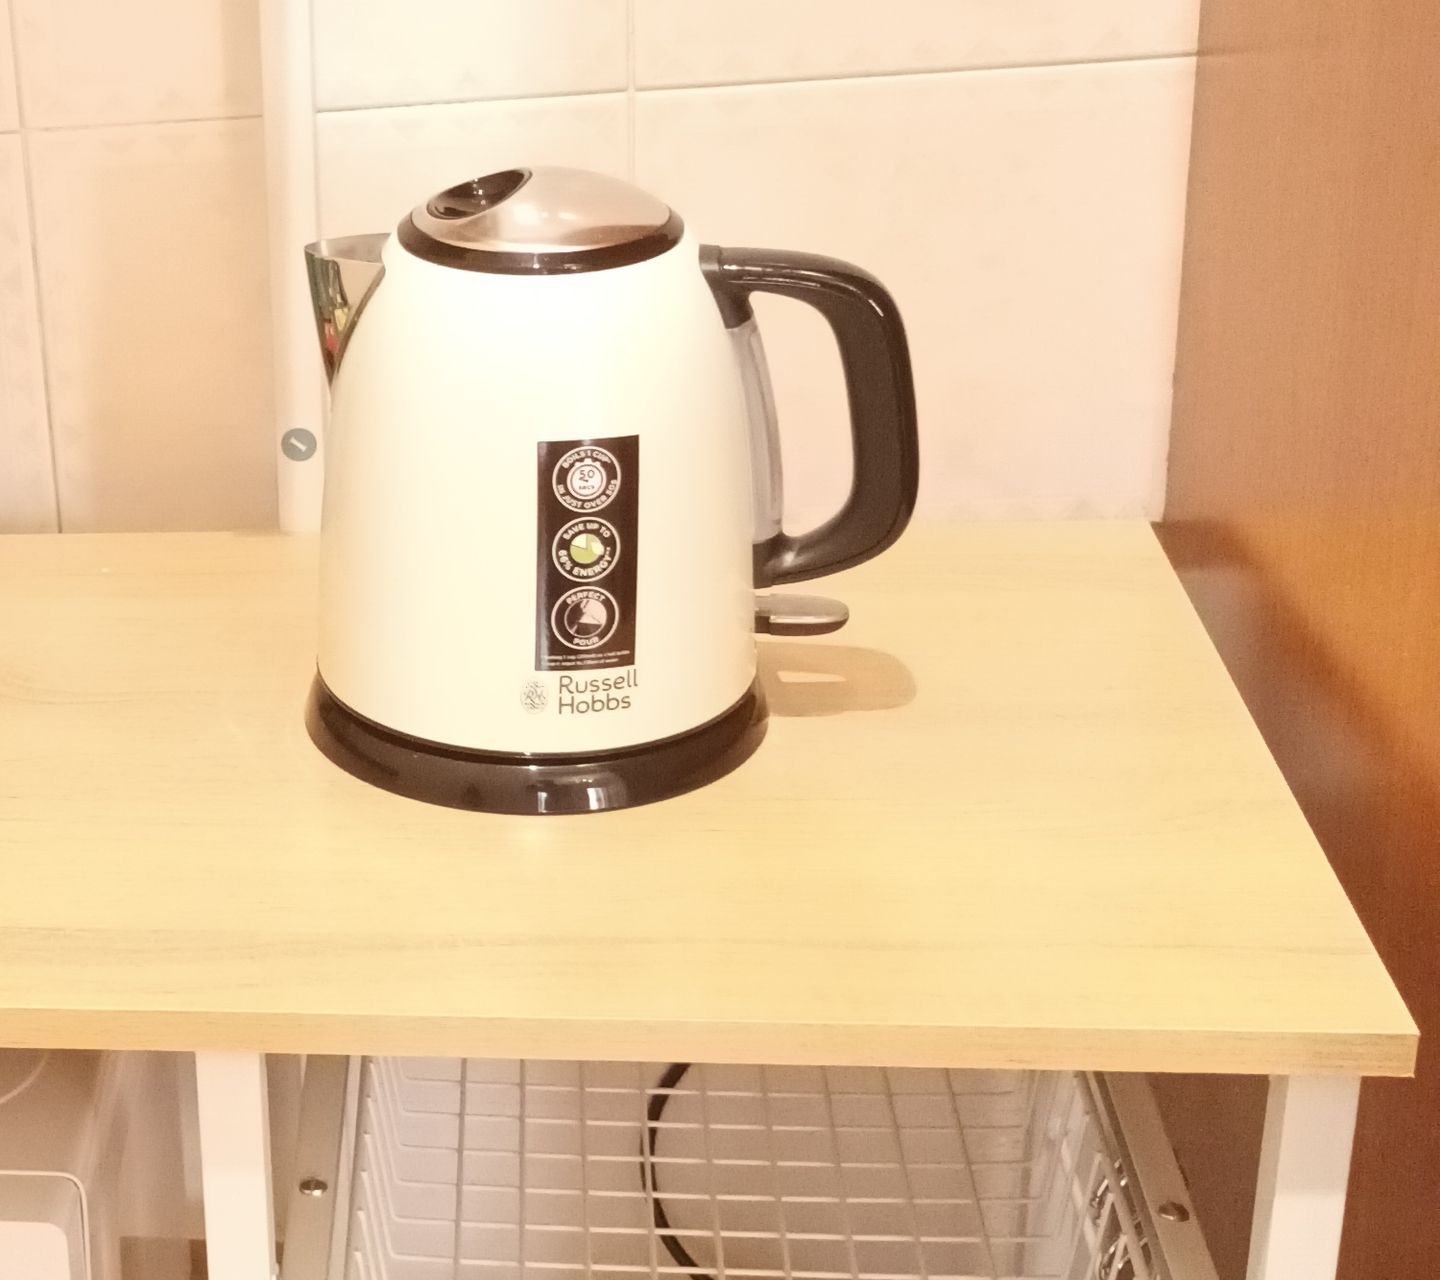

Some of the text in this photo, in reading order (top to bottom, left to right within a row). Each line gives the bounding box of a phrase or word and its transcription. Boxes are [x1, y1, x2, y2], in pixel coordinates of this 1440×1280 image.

[565, 591, 606, 605] PERFECT
[572, 636, 600, 646] POUR
[559, 668, 639, 695] Russell
[558, 692, 632, 715] Hobbs
